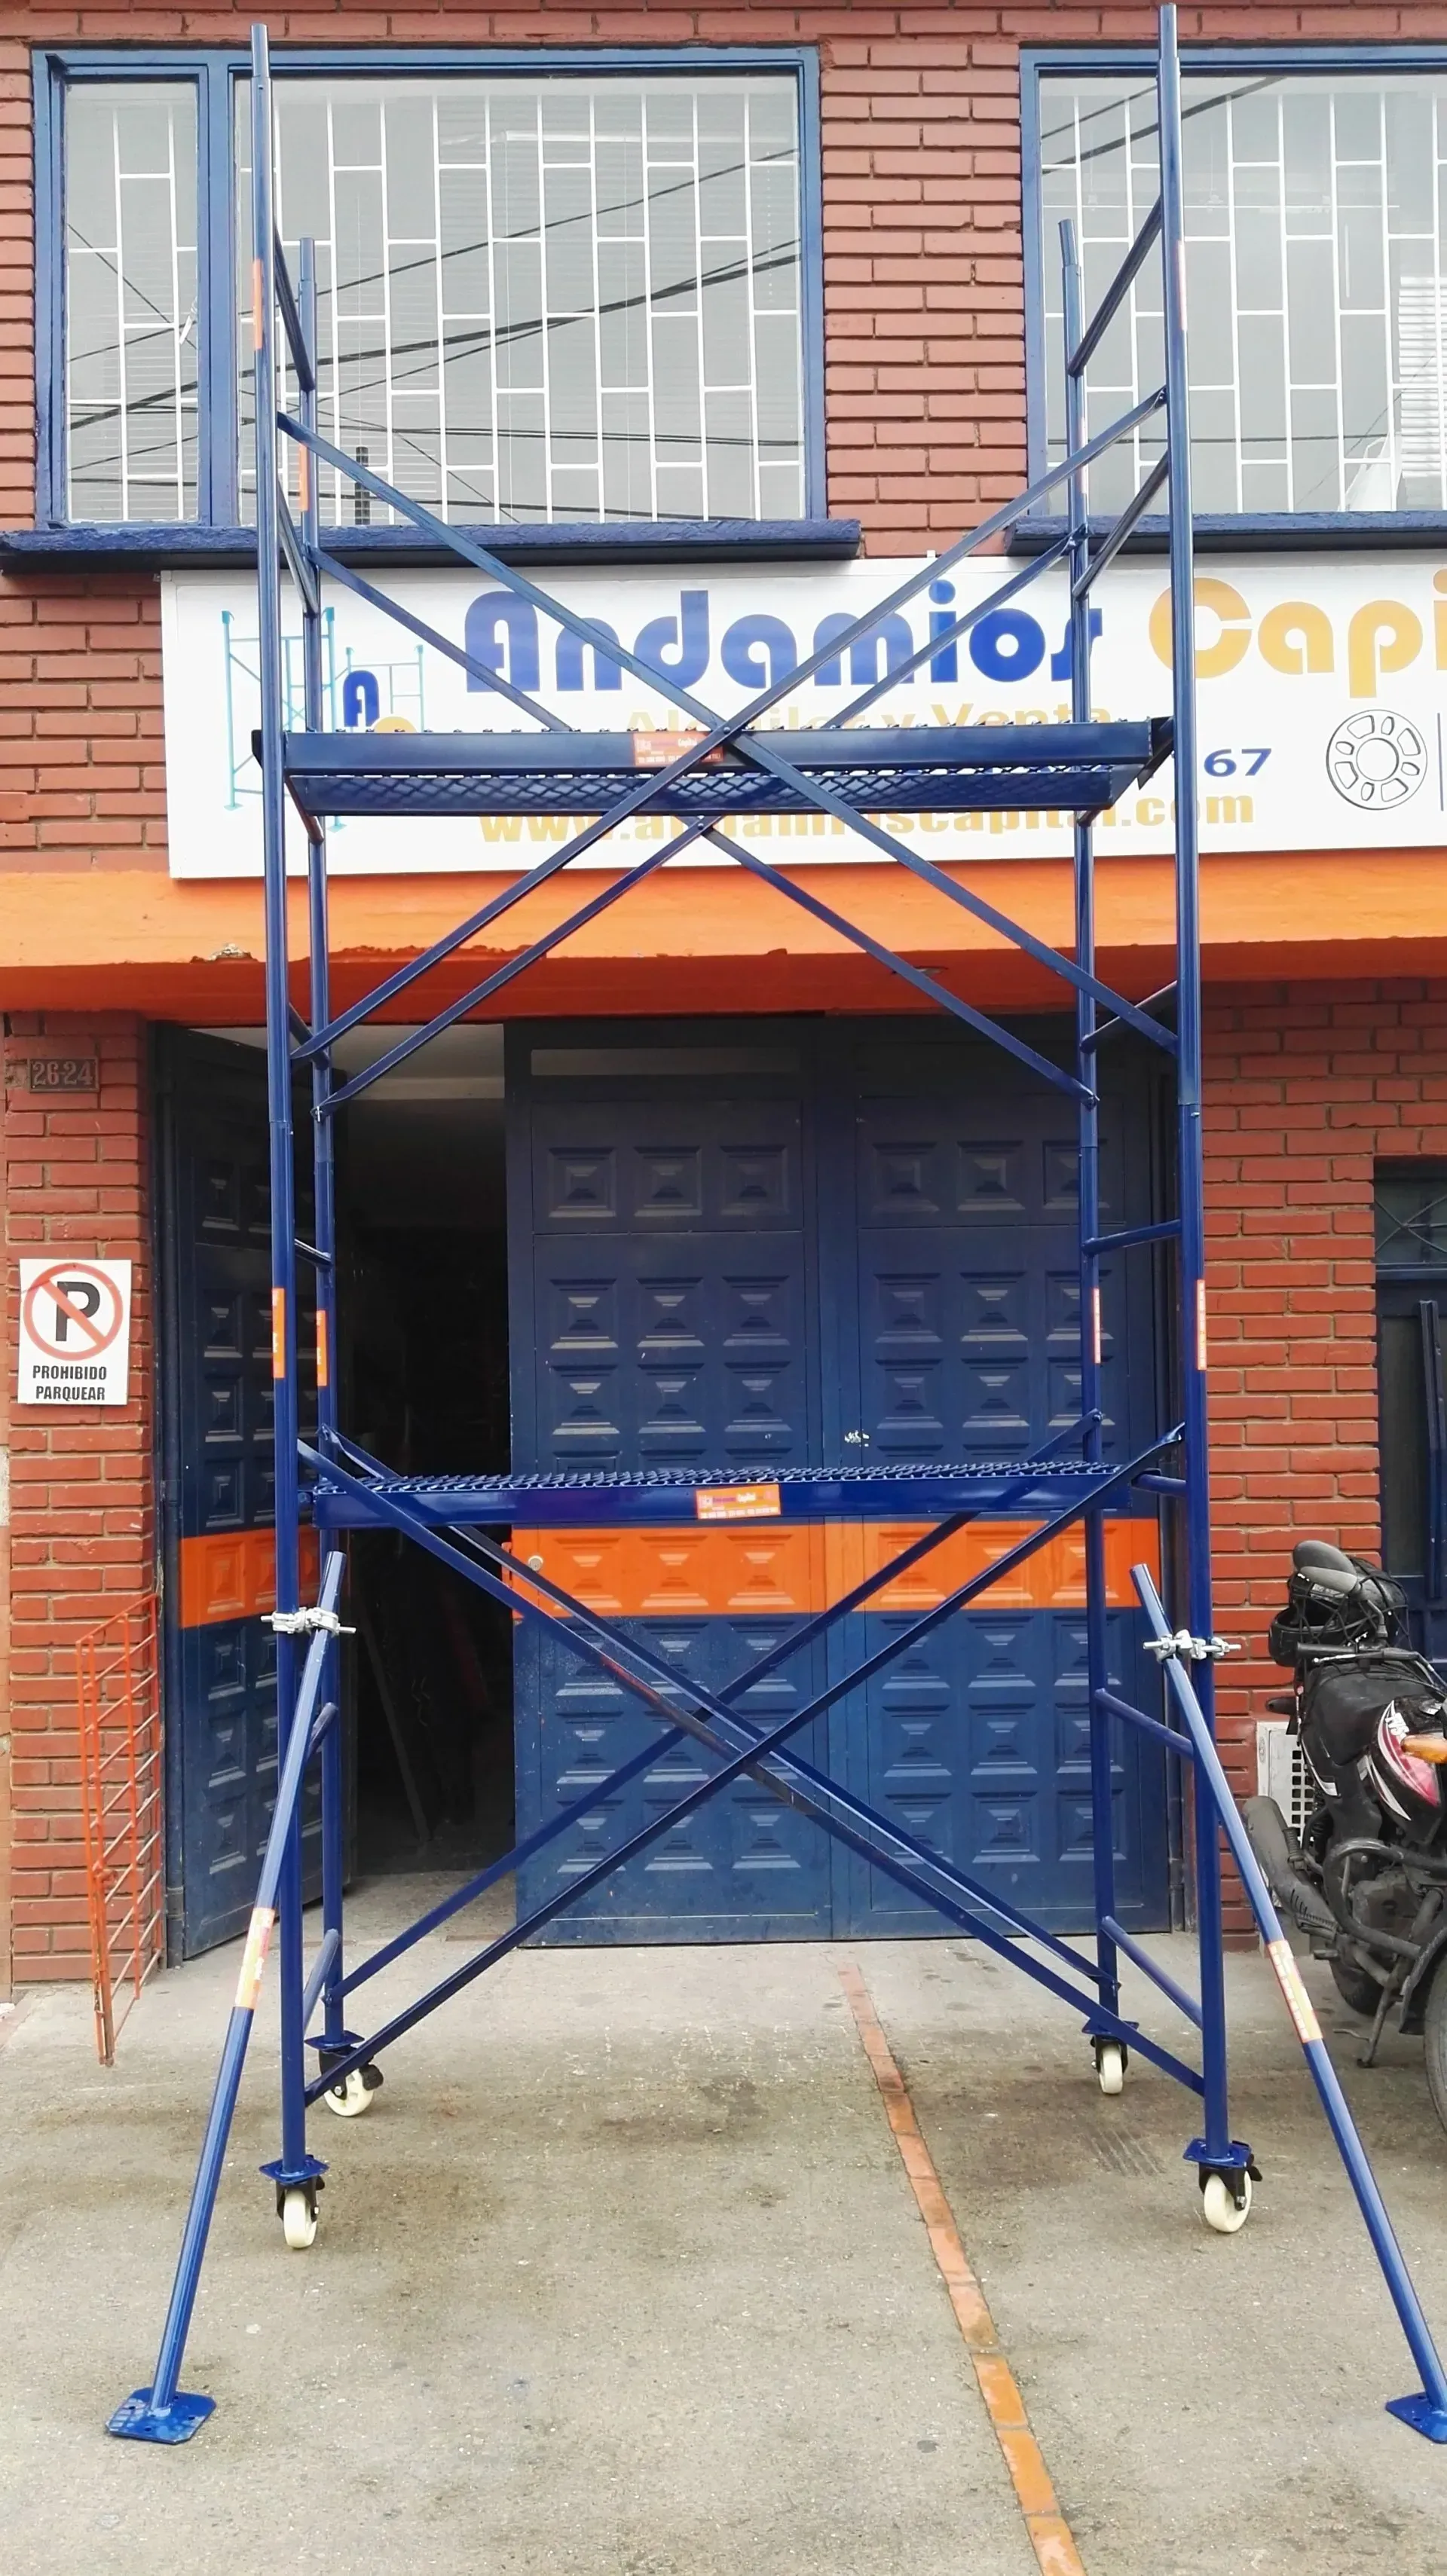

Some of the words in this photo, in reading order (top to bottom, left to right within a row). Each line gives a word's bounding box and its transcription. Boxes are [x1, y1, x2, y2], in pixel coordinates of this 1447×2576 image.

[465, 579, 1103, 692] Andamios
[55, 1281, 101, 1342] P
[32, 1364, 107, 1380] PROHIBIDO
[35, 1386, 106, 1401] PARQUEAR
